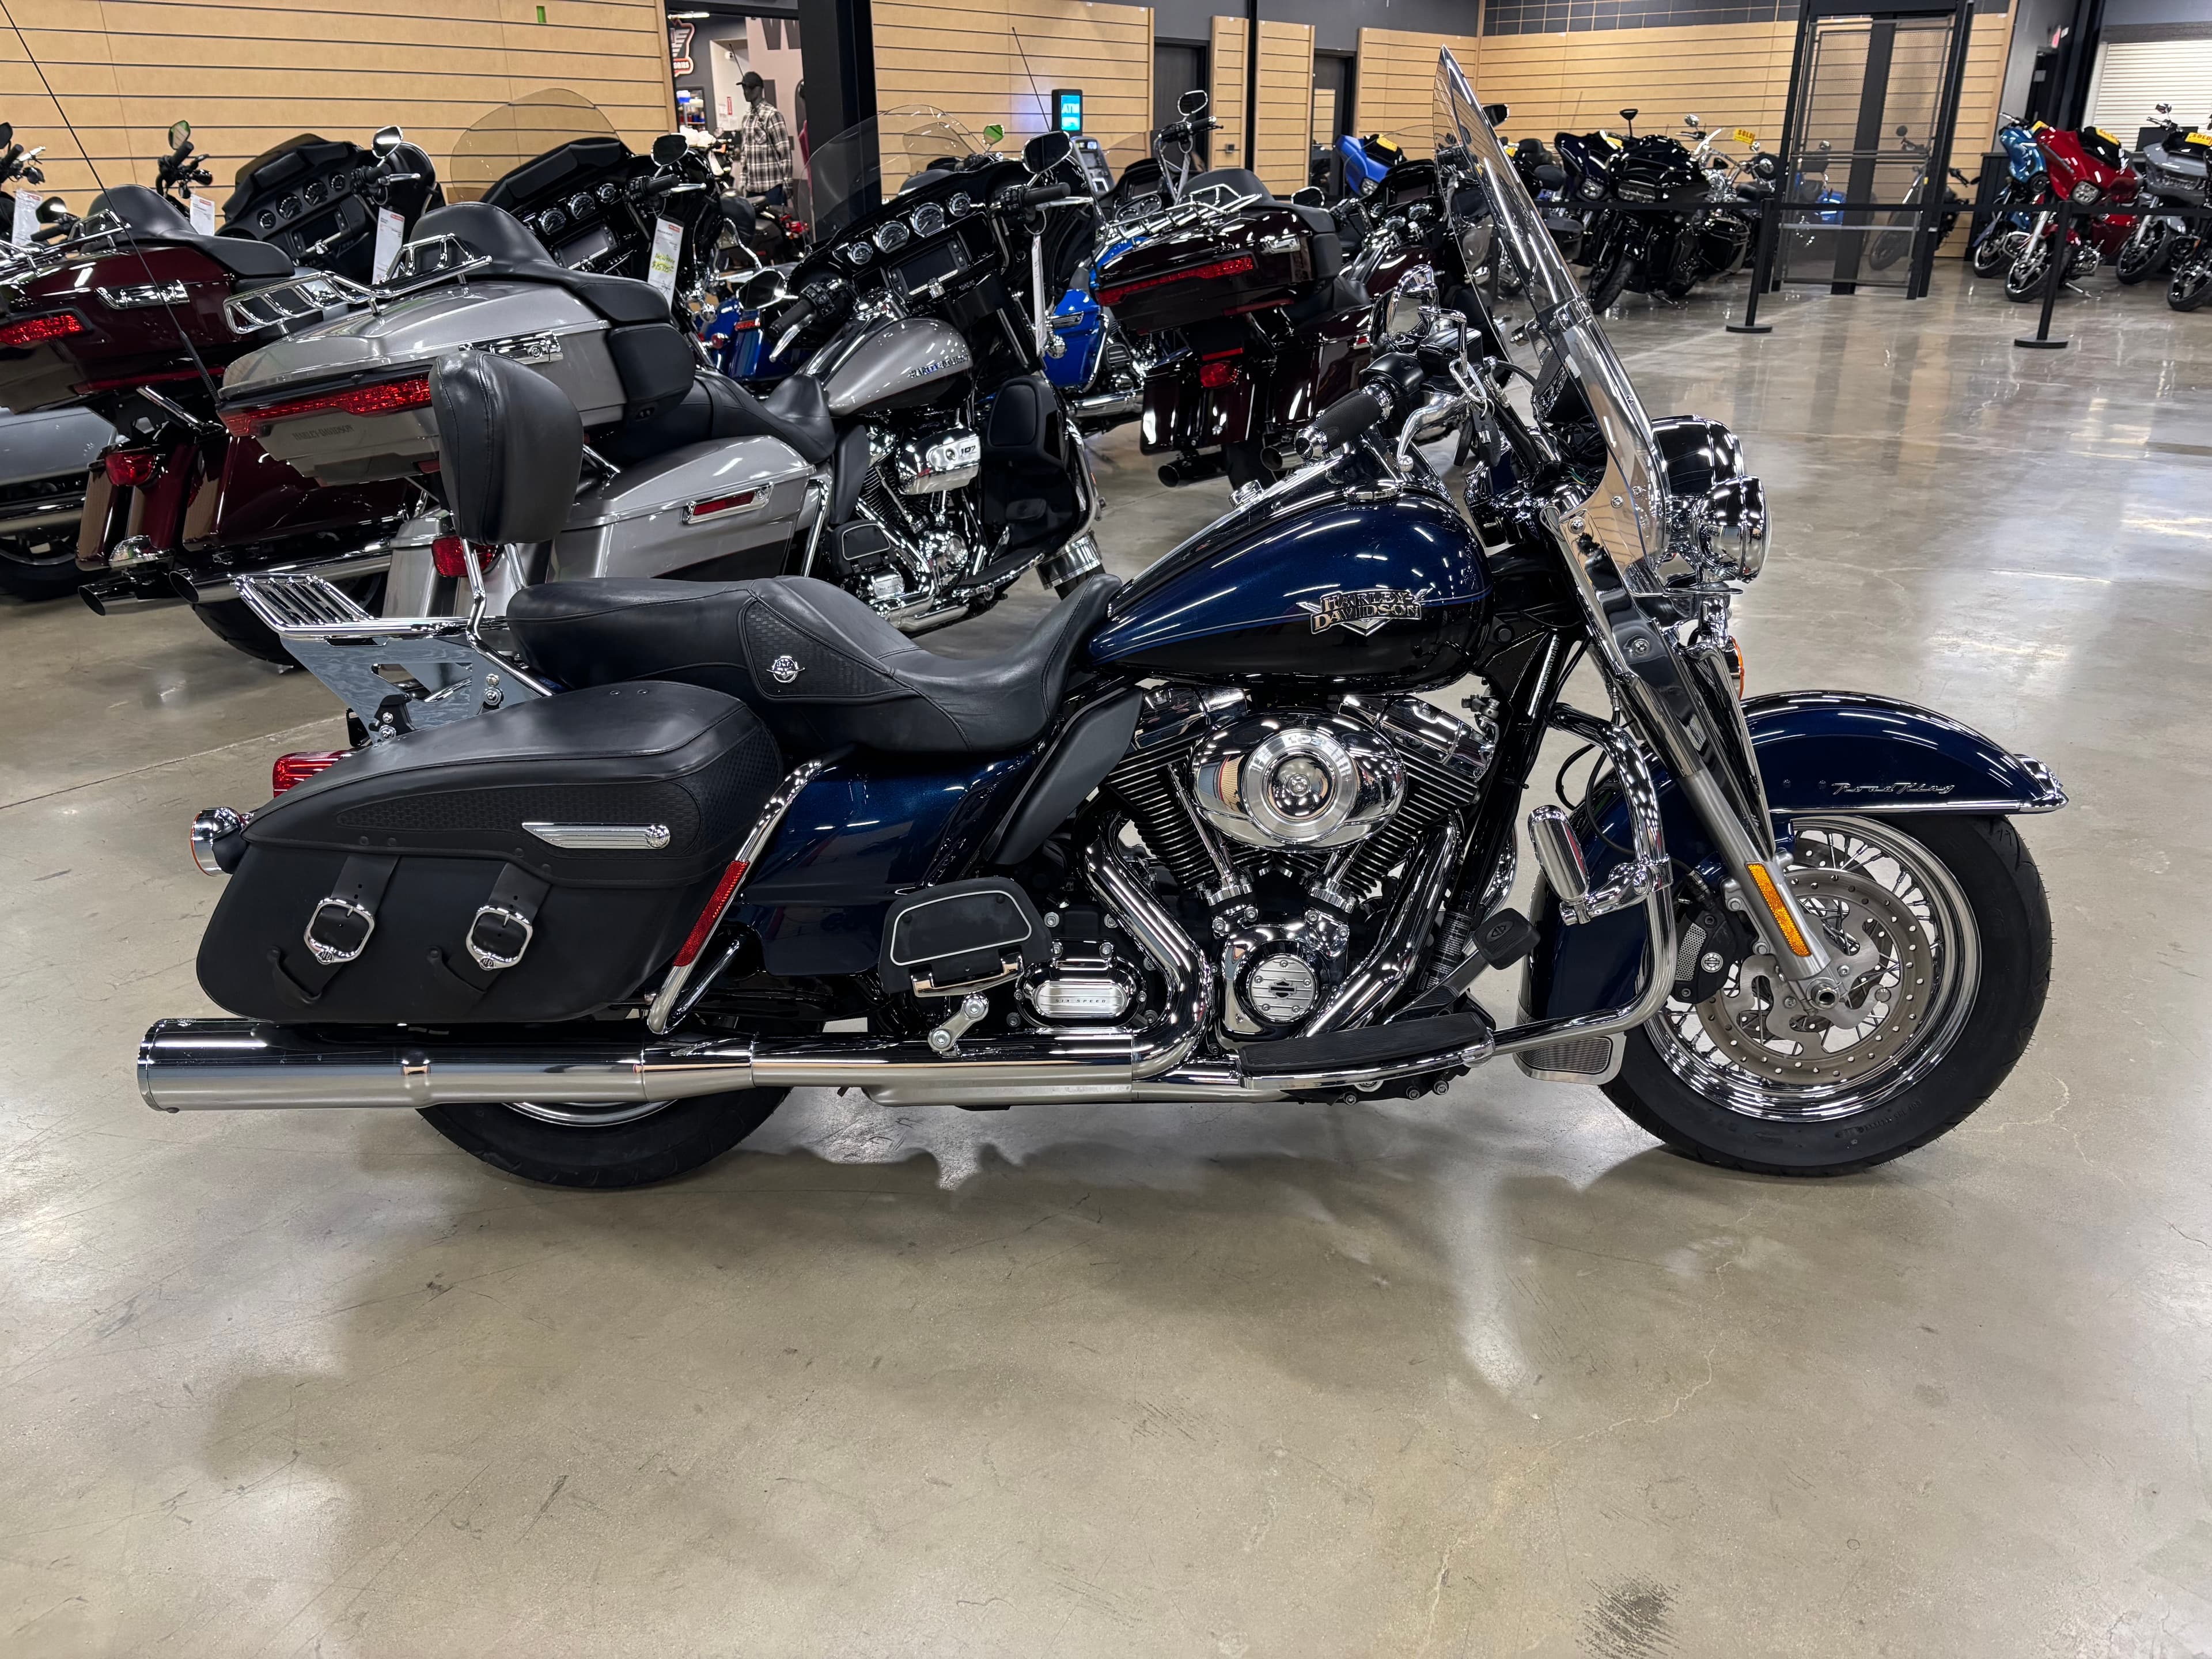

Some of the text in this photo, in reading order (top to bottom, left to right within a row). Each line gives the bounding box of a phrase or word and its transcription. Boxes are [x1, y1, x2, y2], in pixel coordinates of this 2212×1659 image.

[1062, 103, 1080, 114] ATM
[1313, 604, 1419, 631] DAVIDSON
[1831, 782, 1955, 795] Road King
